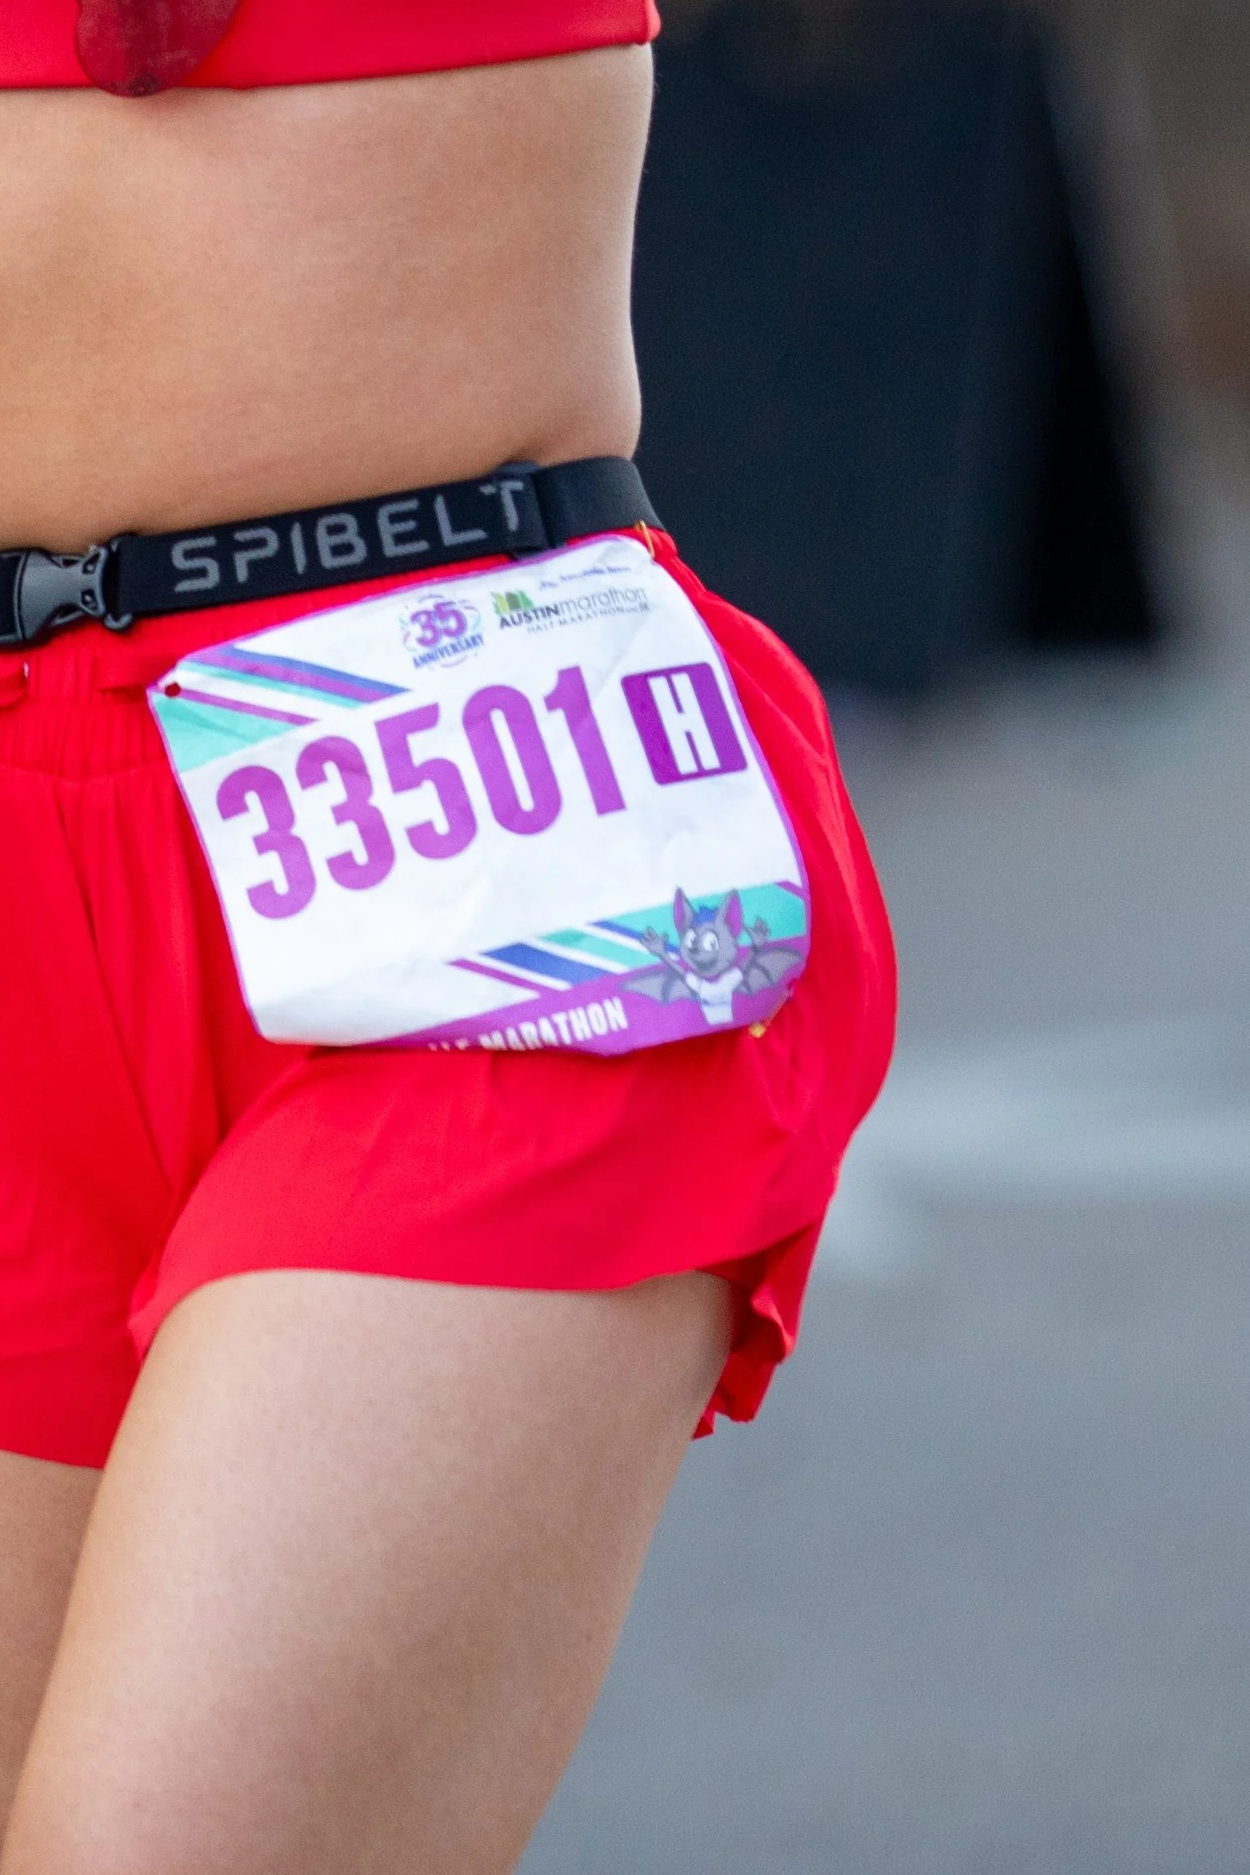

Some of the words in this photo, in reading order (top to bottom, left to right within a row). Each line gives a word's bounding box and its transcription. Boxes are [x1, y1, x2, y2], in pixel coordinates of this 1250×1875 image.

[171, 480, 524, 592] SPIBELT
[409, 601, 468, 648] 35
[412, 633, 485, 669] ANNIVERSARY
[215, 666, 627, 920] 33501
[653, 672, 720, 776] H
[478, 996, 628, 1051] MARATHON
